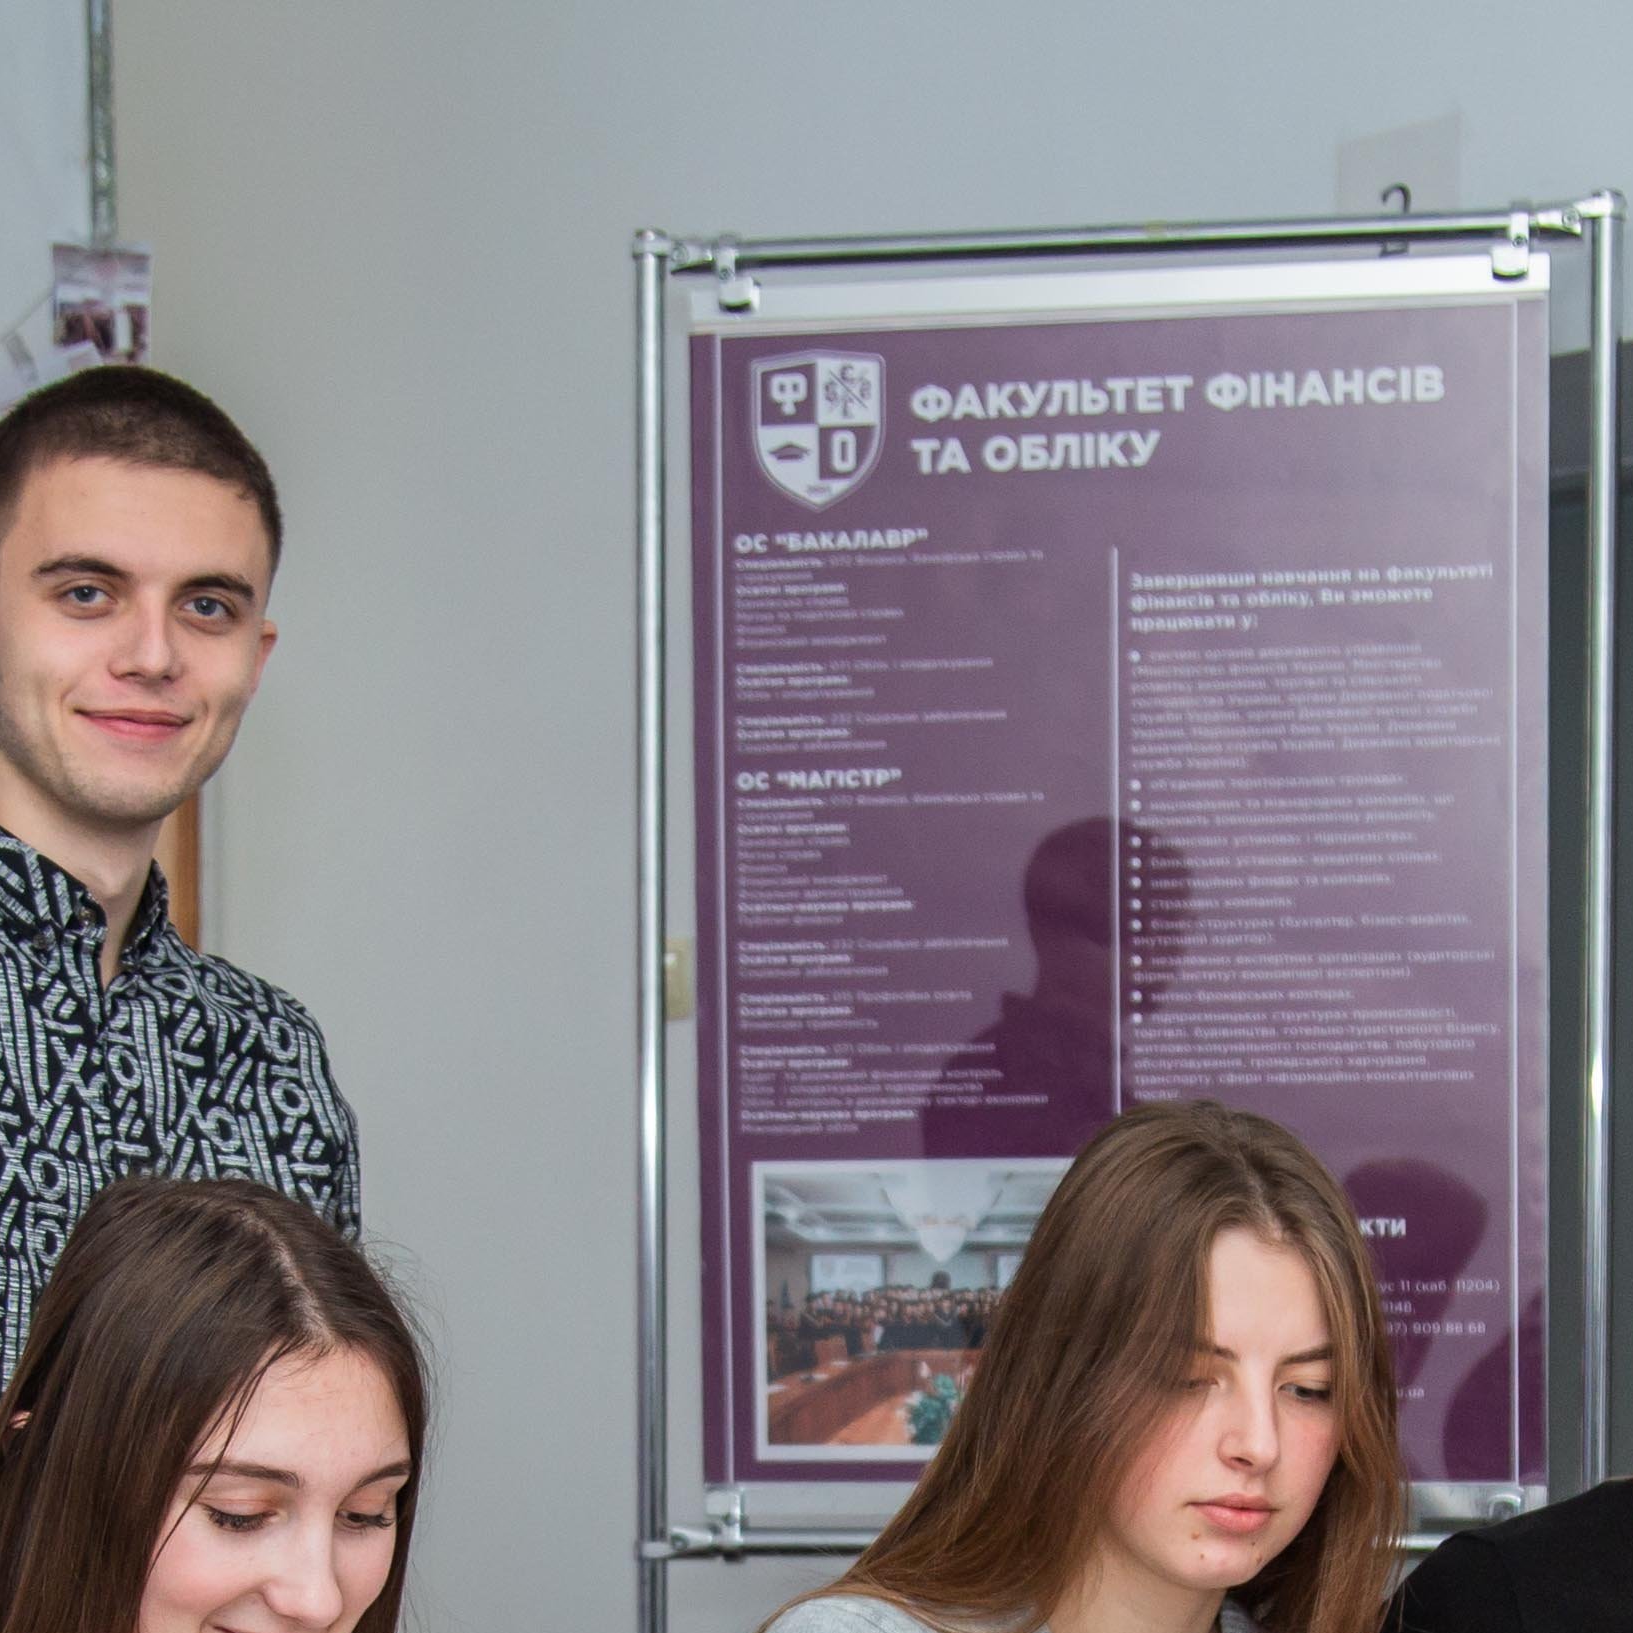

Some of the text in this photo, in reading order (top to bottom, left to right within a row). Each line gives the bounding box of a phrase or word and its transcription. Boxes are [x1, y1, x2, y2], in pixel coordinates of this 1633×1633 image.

[910, 365, 1445, 421] ФАКУЛЬТЕТ ФІНАНСІВ
[910, 430, 1161, 474] ТА ОБЛІКУ
[735, 528, 929, 552] ОС "БАКАЛАВР"
[736, 771, 769, 790] ОС
[1359, 1217, 1407, 1237] КТИ
